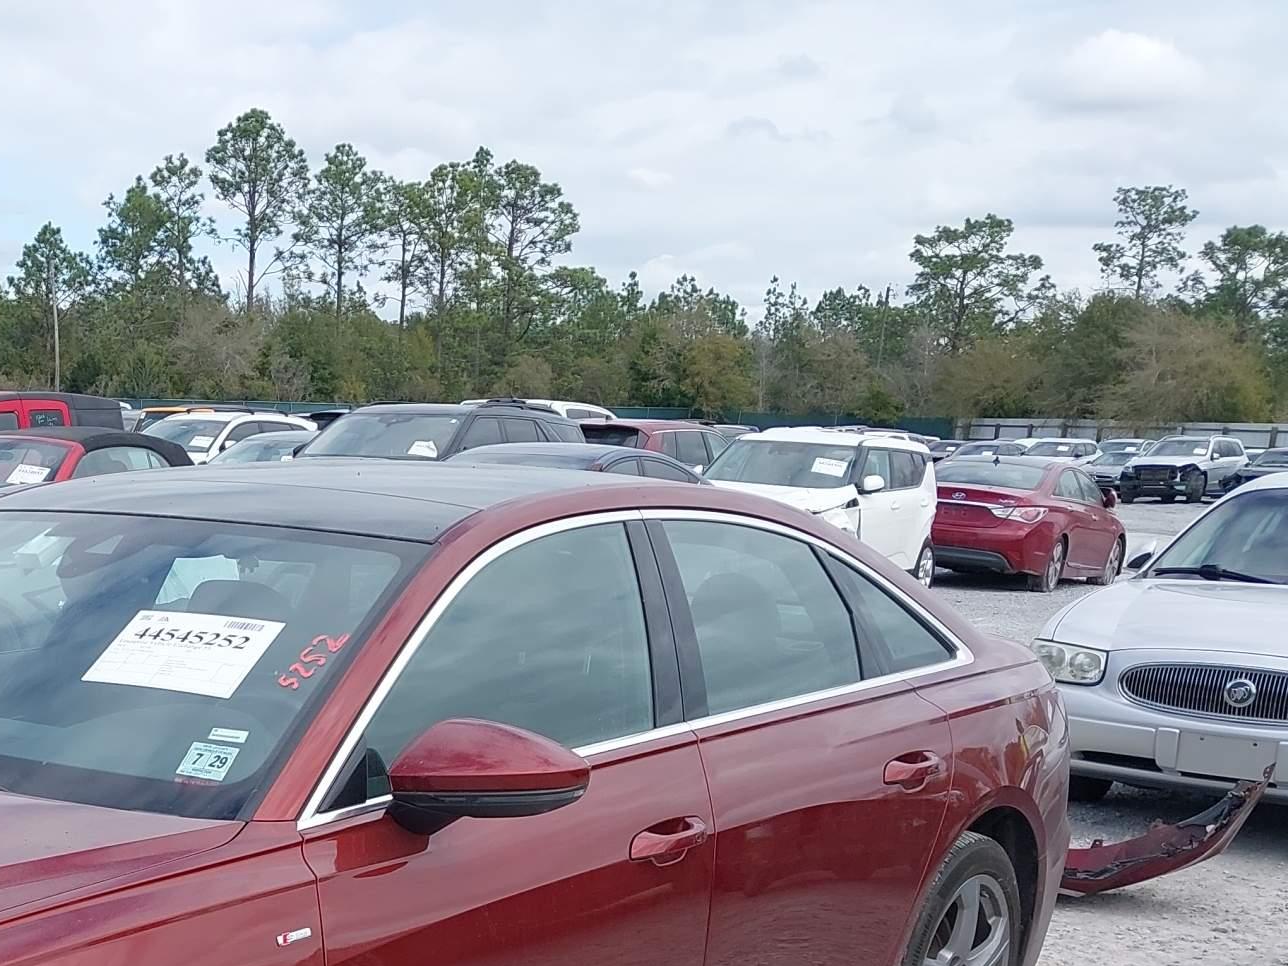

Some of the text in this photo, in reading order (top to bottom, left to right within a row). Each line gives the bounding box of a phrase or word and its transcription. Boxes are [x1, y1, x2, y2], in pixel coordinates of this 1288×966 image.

[133, 626, 251, 650] 44545252
[278, 633, 351, 689] 5252
[191, 752, 229, 770] 7 29
